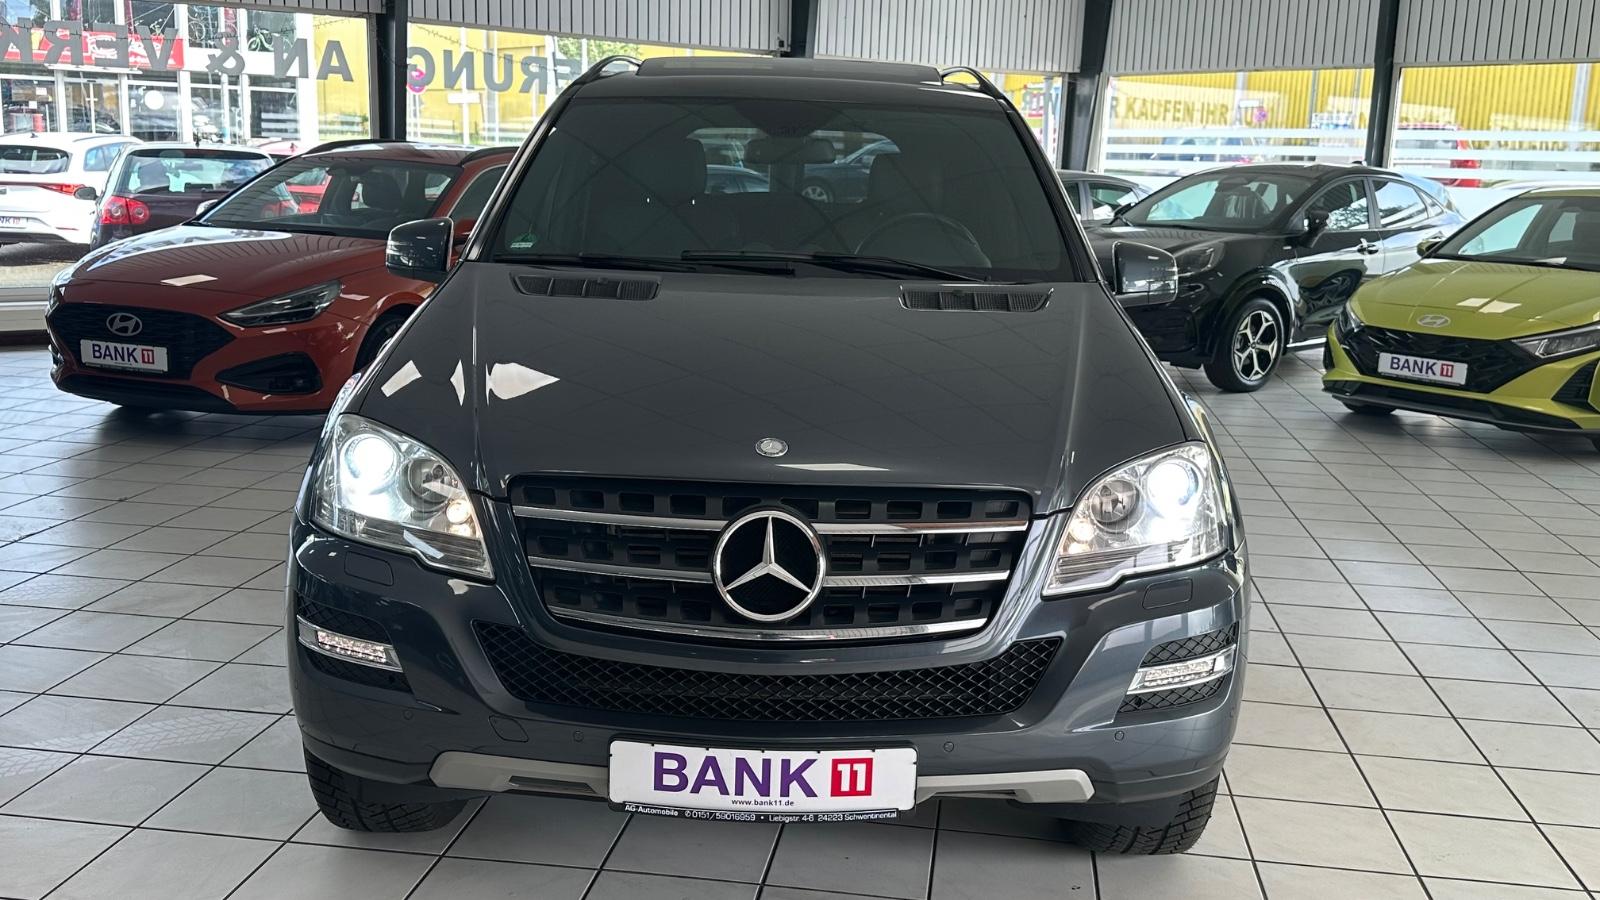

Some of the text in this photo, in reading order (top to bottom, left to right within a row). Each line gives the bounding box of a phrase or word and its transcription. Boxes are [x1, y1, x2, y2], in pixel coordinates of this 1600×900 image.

[92, 344, 153, 363] BANK 11
[1390, 357, 1452, 377] BANK 11
[653, 751, 867, 797] BANK 11
[731, 797, 794, 807] www.bank11.de
[817, 814, 844, 822] 24223
